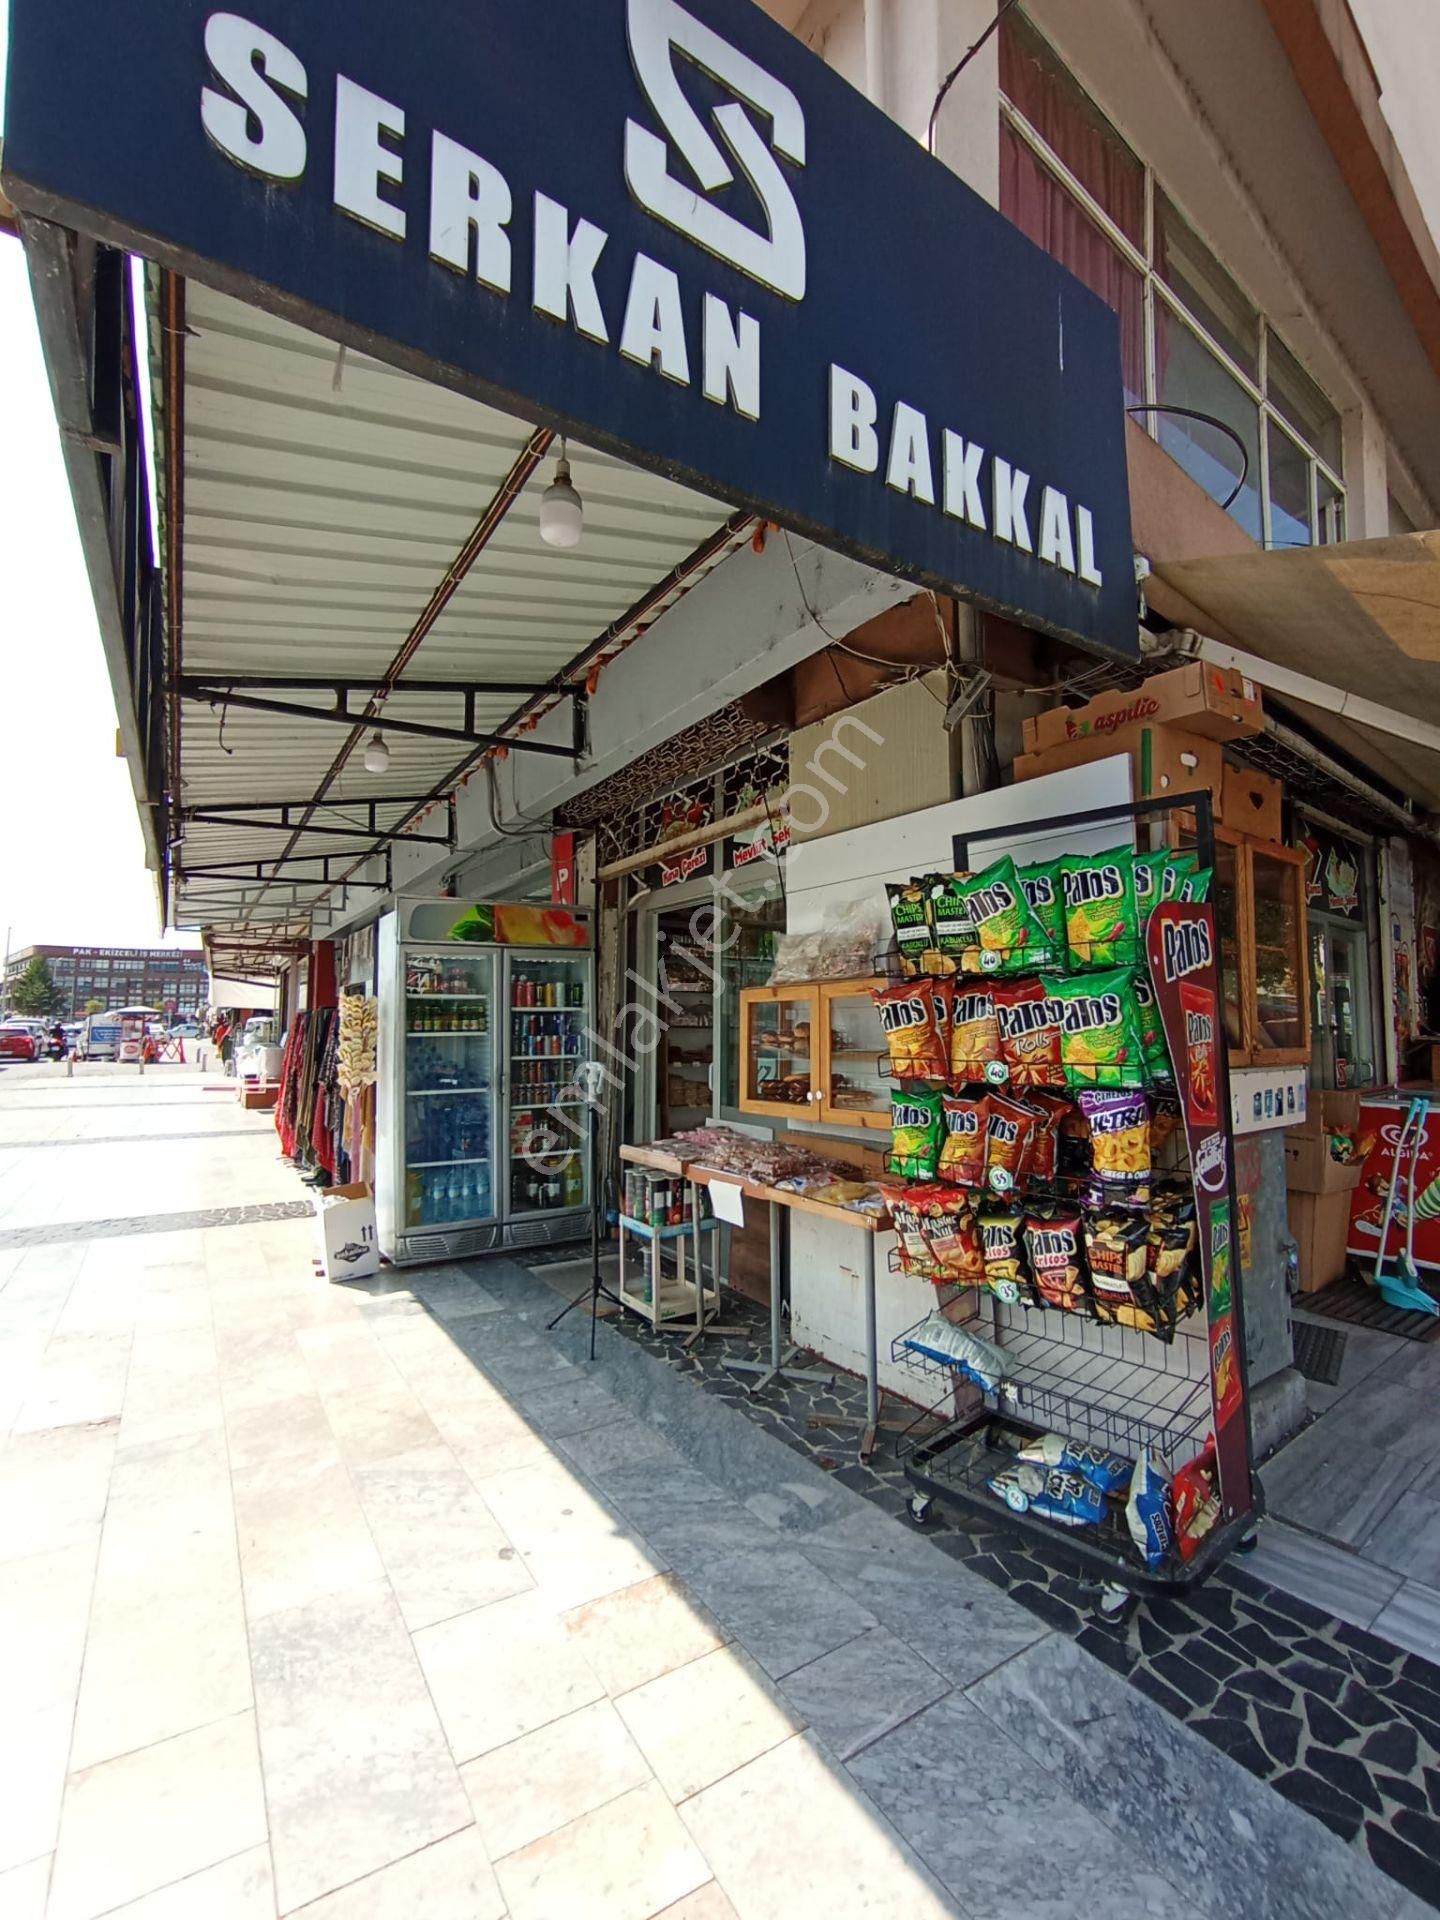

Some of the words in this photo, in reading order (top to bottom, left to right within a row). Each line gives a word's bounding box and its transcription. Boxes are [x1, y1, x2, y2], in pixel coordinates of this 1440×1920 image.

[201, 11, 761, 421] SERKAN
[828, 362, 1103, 588] BAKKAL
[1088, 1248, 1123, 1265] CHIPS
